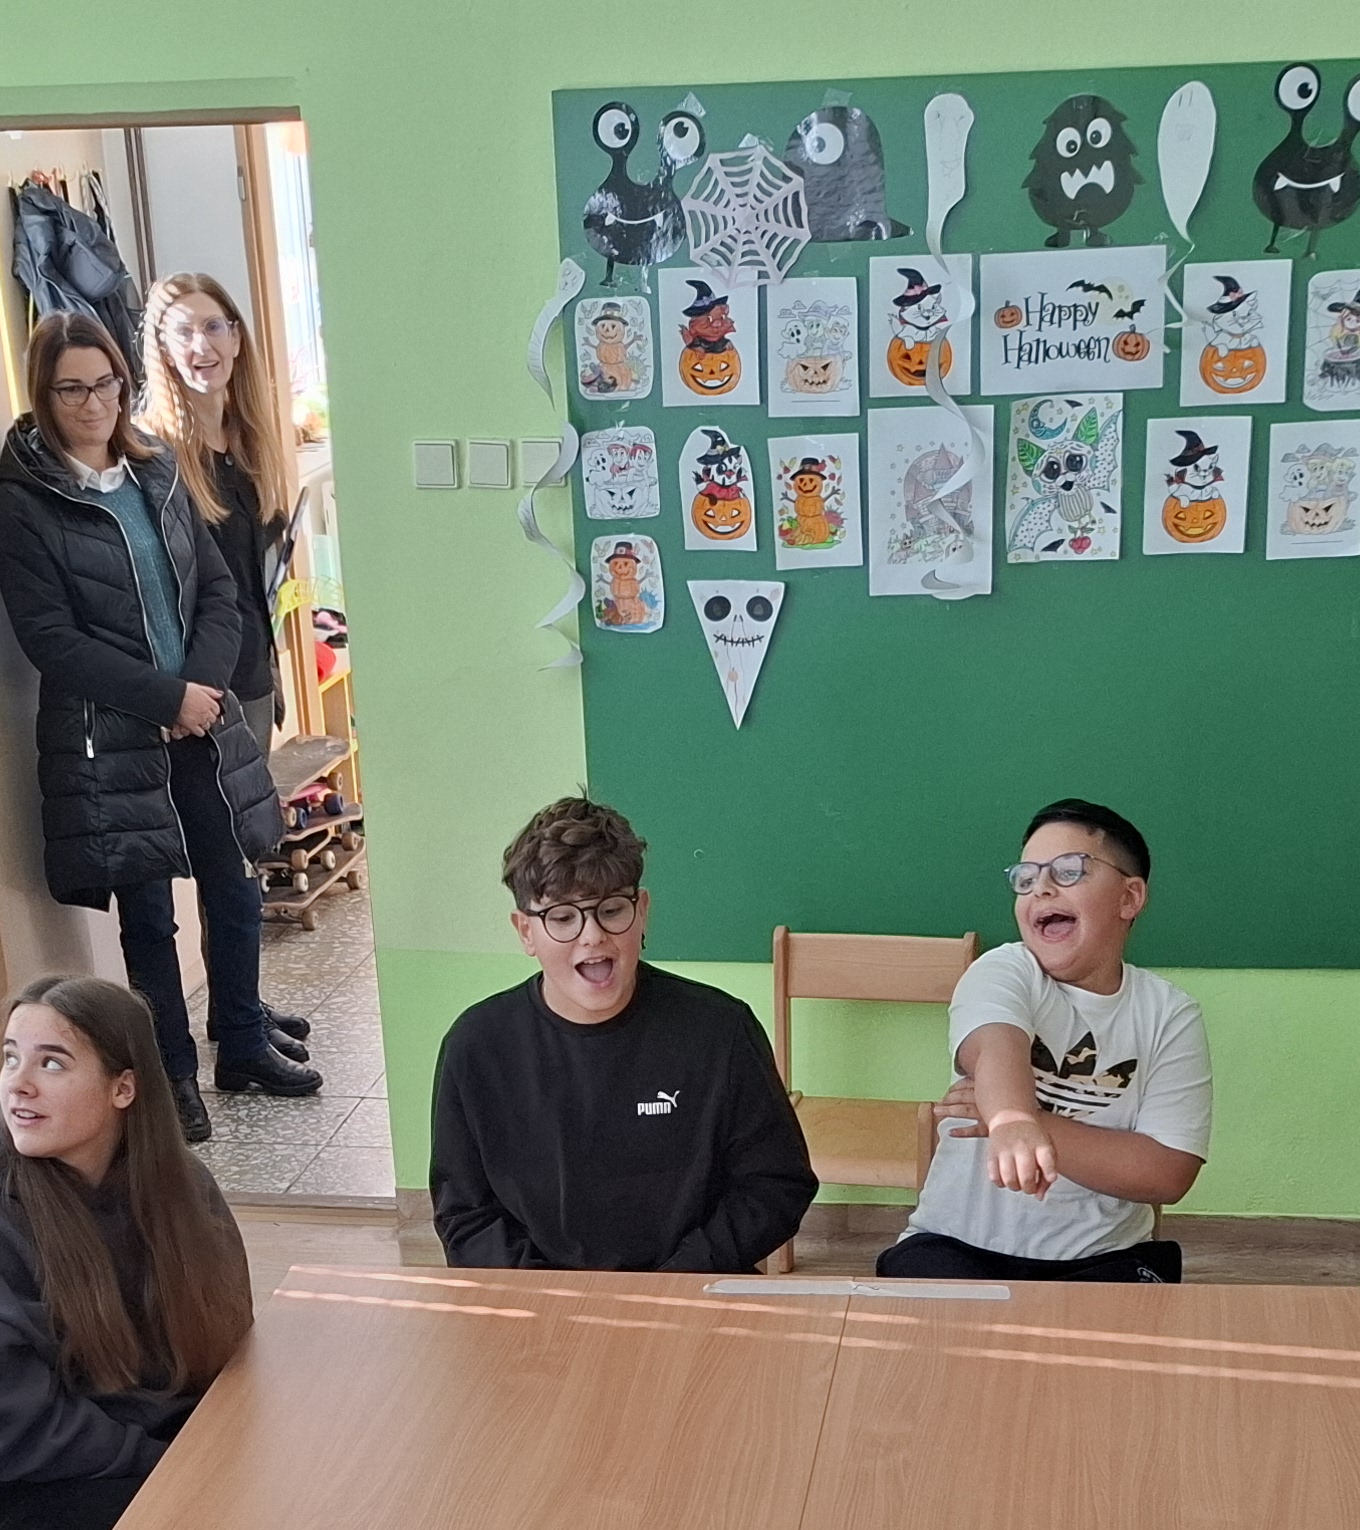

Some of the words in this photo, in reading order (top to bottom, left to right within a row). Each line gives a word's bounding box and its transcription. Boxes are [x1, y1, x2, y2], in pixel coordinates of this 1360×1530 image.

[1022, 291, 1100, 333] Happy
[1001, 328, 1111, 370] Halloween
[637, 1101, 672, 1116] PUMA
